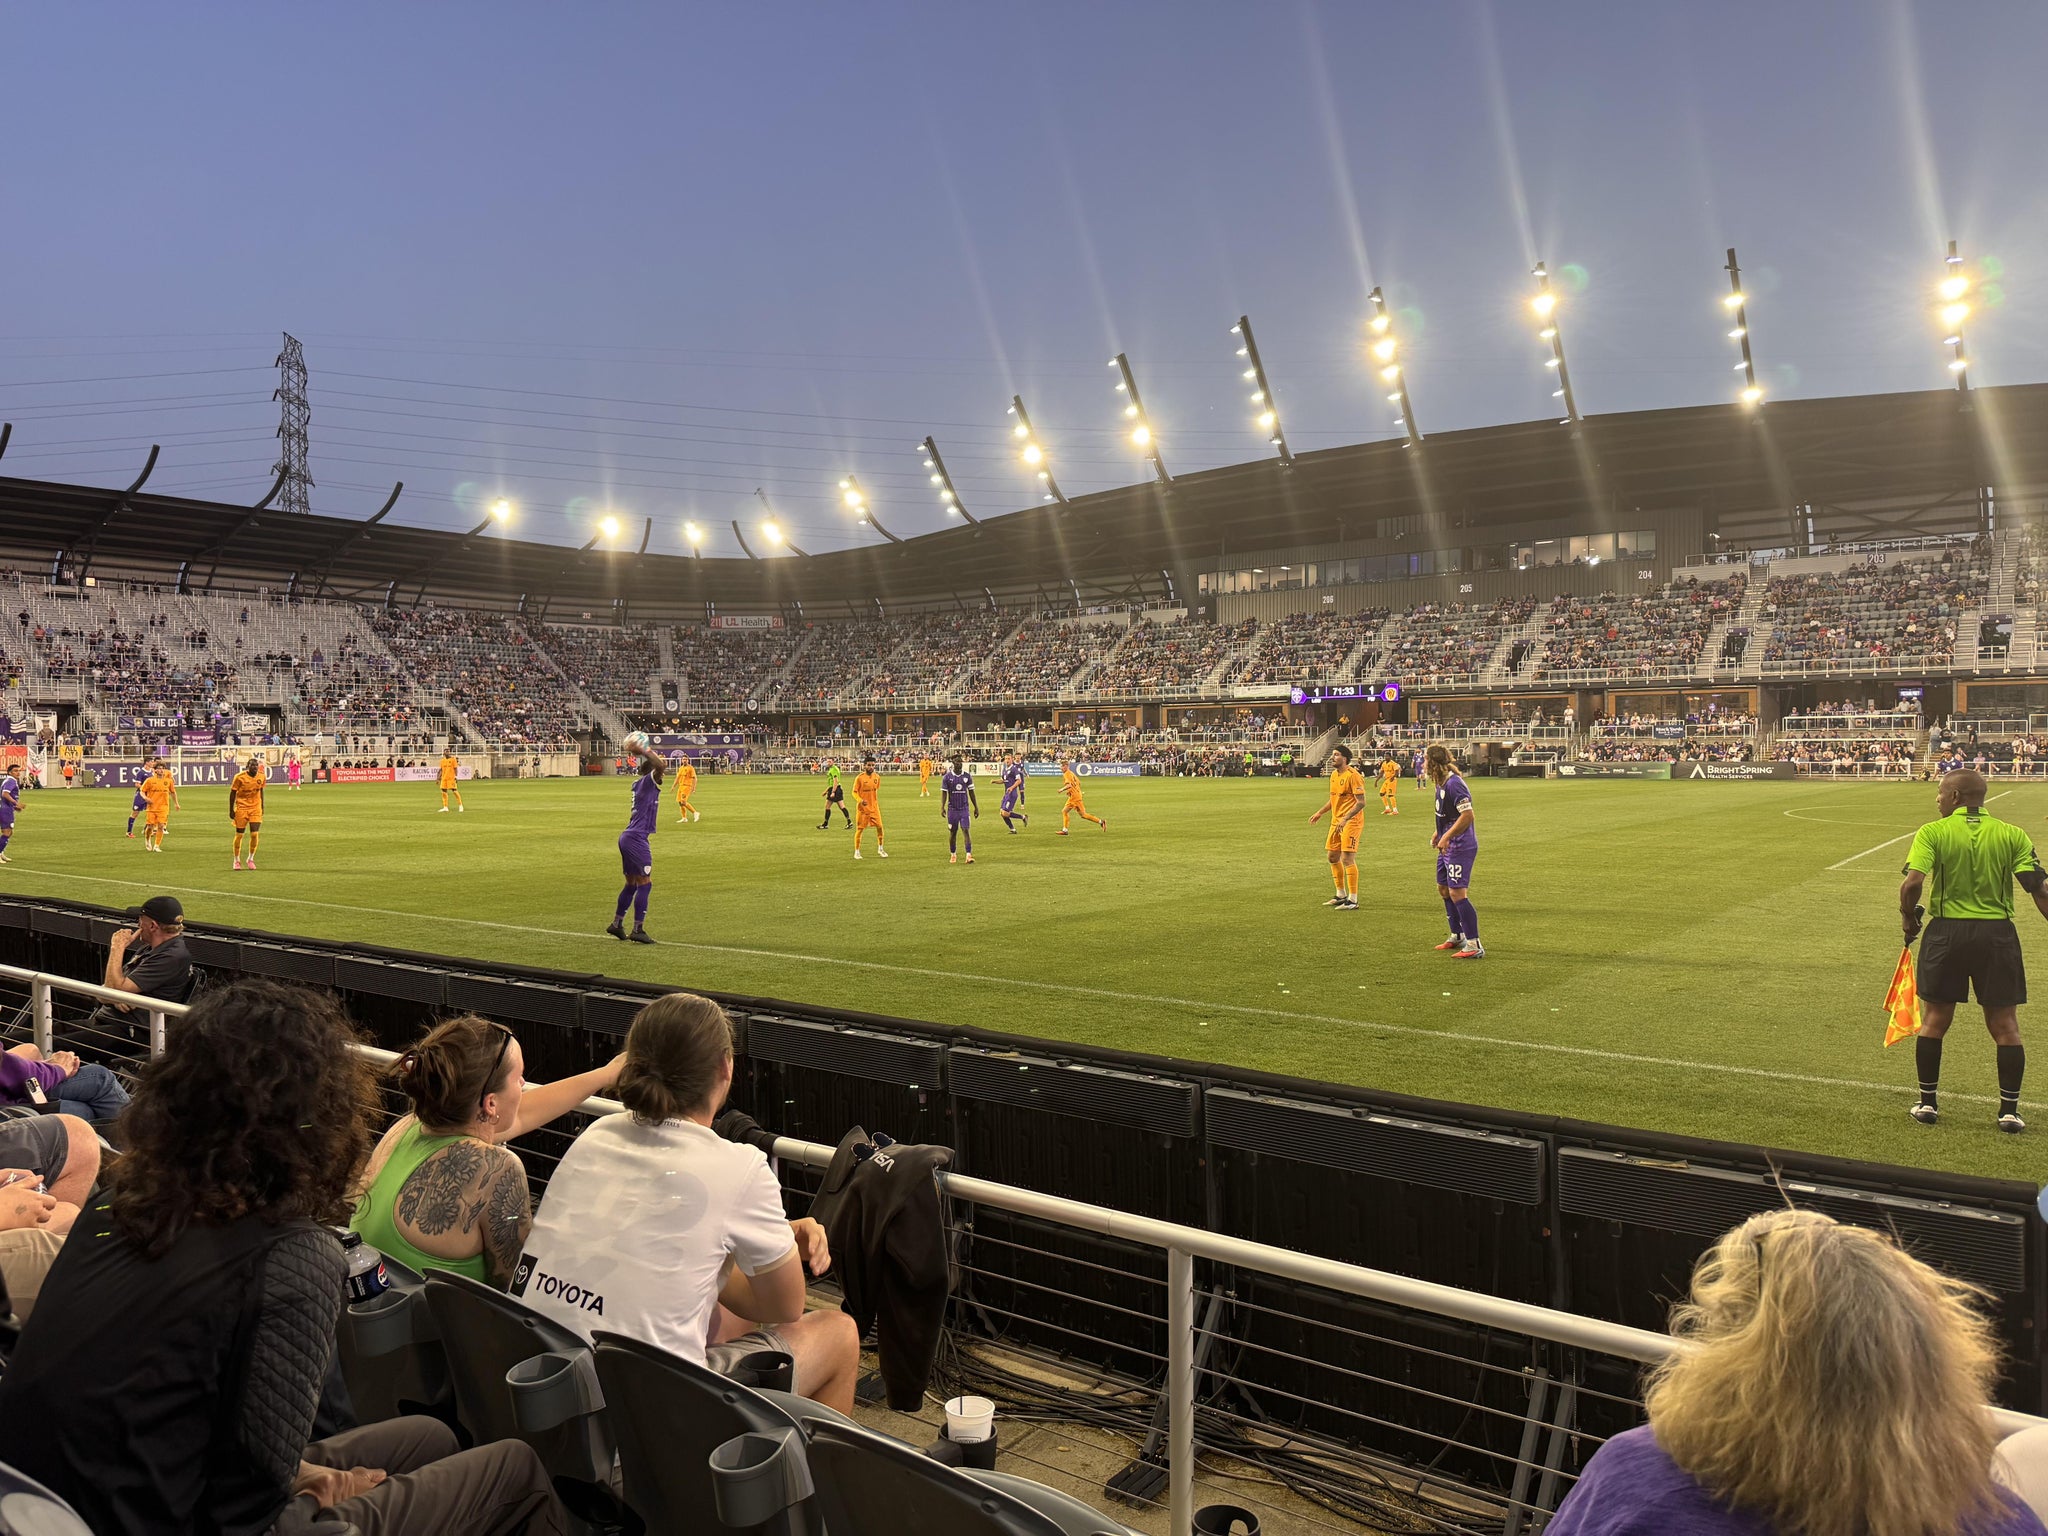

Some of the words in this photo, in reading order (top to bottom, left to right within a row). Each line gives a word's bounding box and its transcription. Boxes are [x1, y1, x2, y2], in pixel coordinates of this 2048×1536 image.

[1868, 554, 1885, 563] 203
[64, 570, 74, 579] 114
[1638, 570, 1652, 579] 204
[1460, 583, 1473, 593] 205
[710, 617, 721, 627] 211
[726, 617, 739, 626] UL
[741, 617, 771, 627] Health
[773, 617, 784, 626] 211
[1313, 687, 1320, 697] 1
[1332, 686, 1355, 696] 71:33
[1368, 685, 1375, 696] 1
[148, 718, 166, 727] THE
[1093, 766, 1116, 774] Central
[1117, 766, 1134, 774] Bank
[1448, 864, 1462, 878] 32
[536, 1271, 604, 1316] TOYOTA
